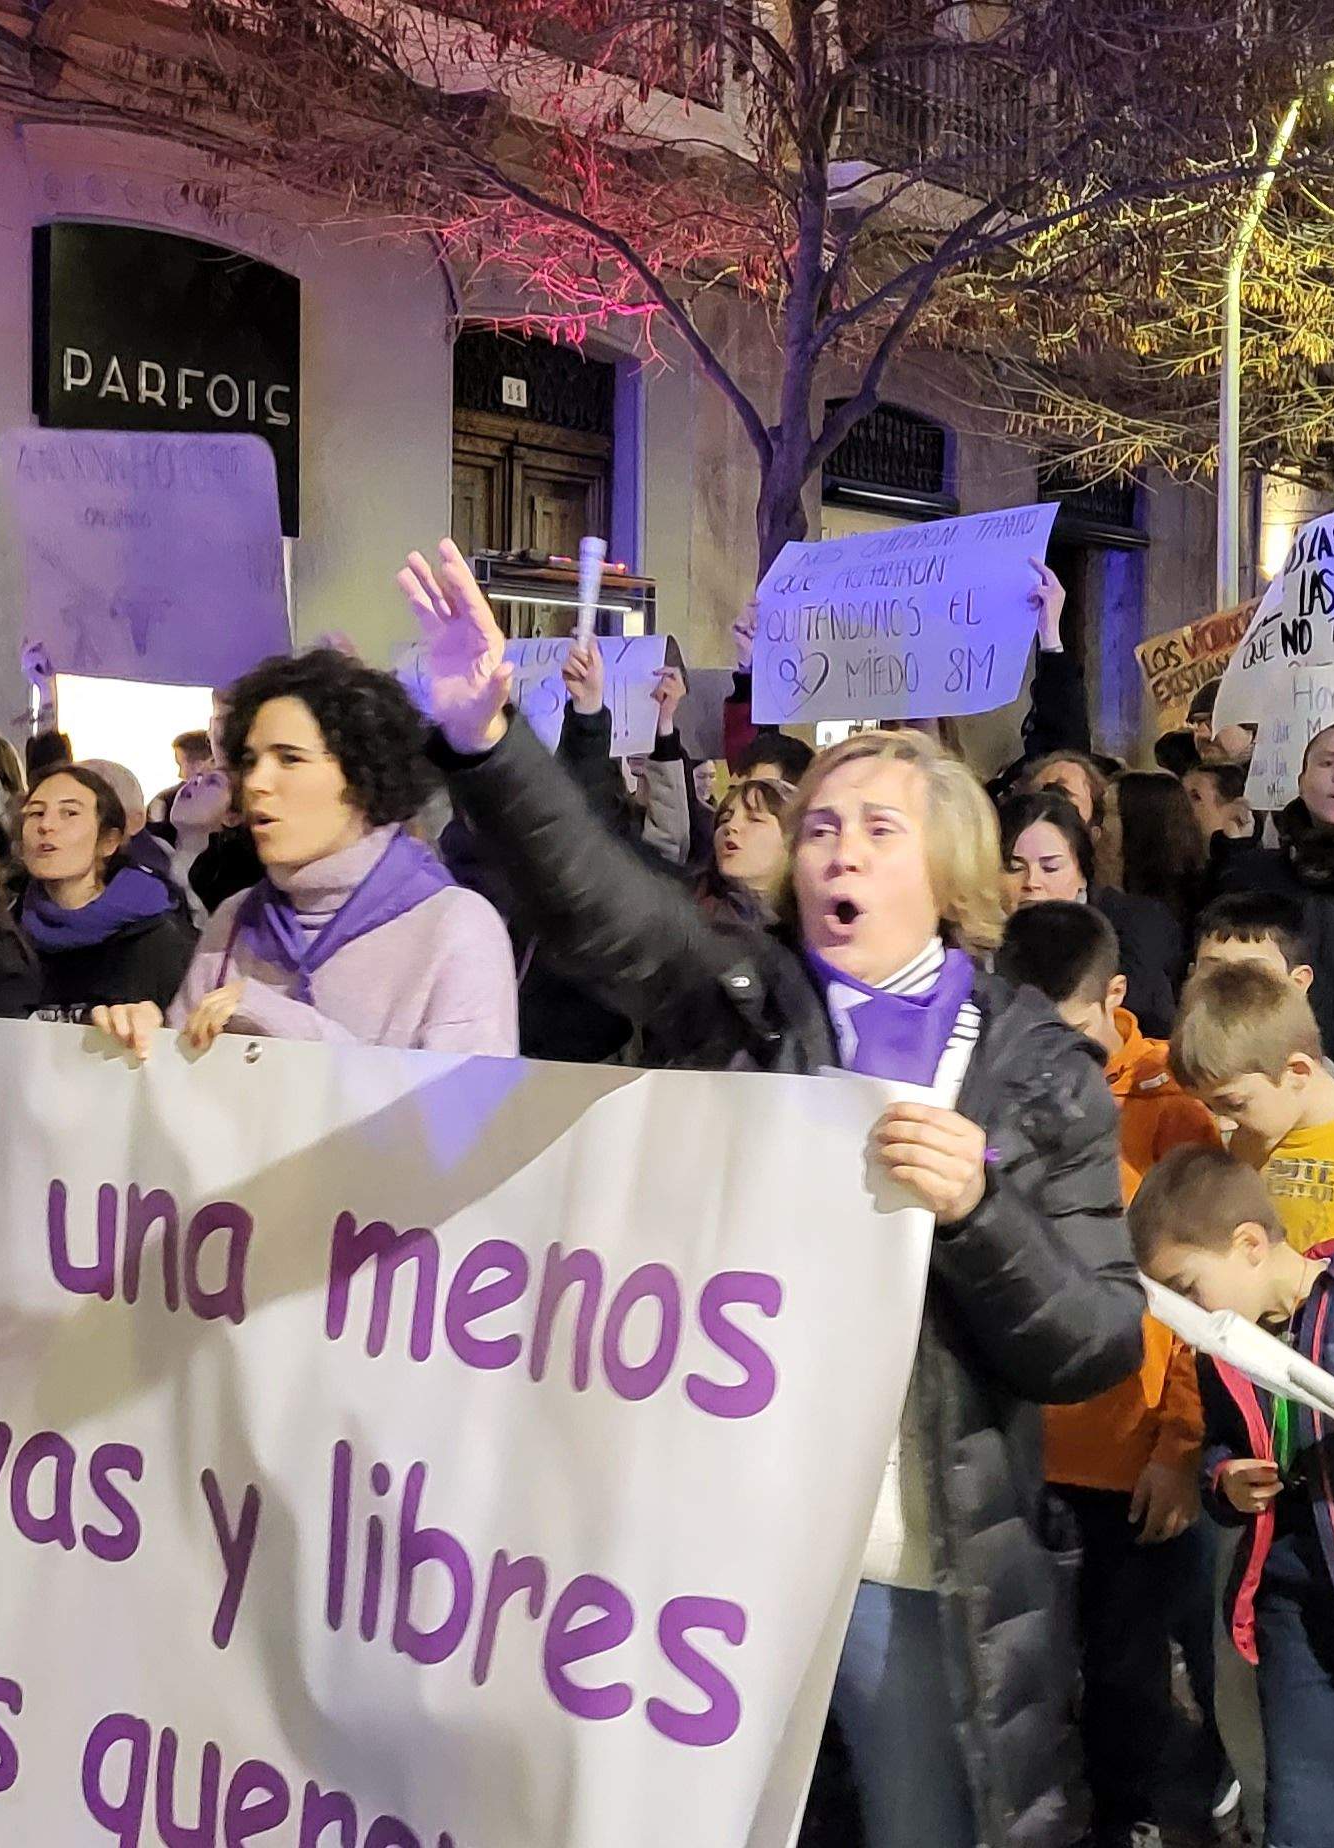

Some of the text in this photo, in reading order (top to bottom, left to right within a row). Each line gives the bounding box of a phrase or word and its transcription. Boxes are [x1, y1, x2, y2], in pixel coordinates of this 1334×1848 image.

[63, 347, 291, 426] PARFOIS
[949, 589, 983, 626] EL
[944, 643, 996, 693] 8M
[1140, 640, 1183, 679] LOS
[1242, 629, 1276, 670] QUE
[1280, 618, 1313, 657] NO
[48, 1176, 254, 1325] una
[325, 1209, 784, 1420] menos
[201, 1467, 260, 1650] y
[325, 1438, 748, 1748] libres
